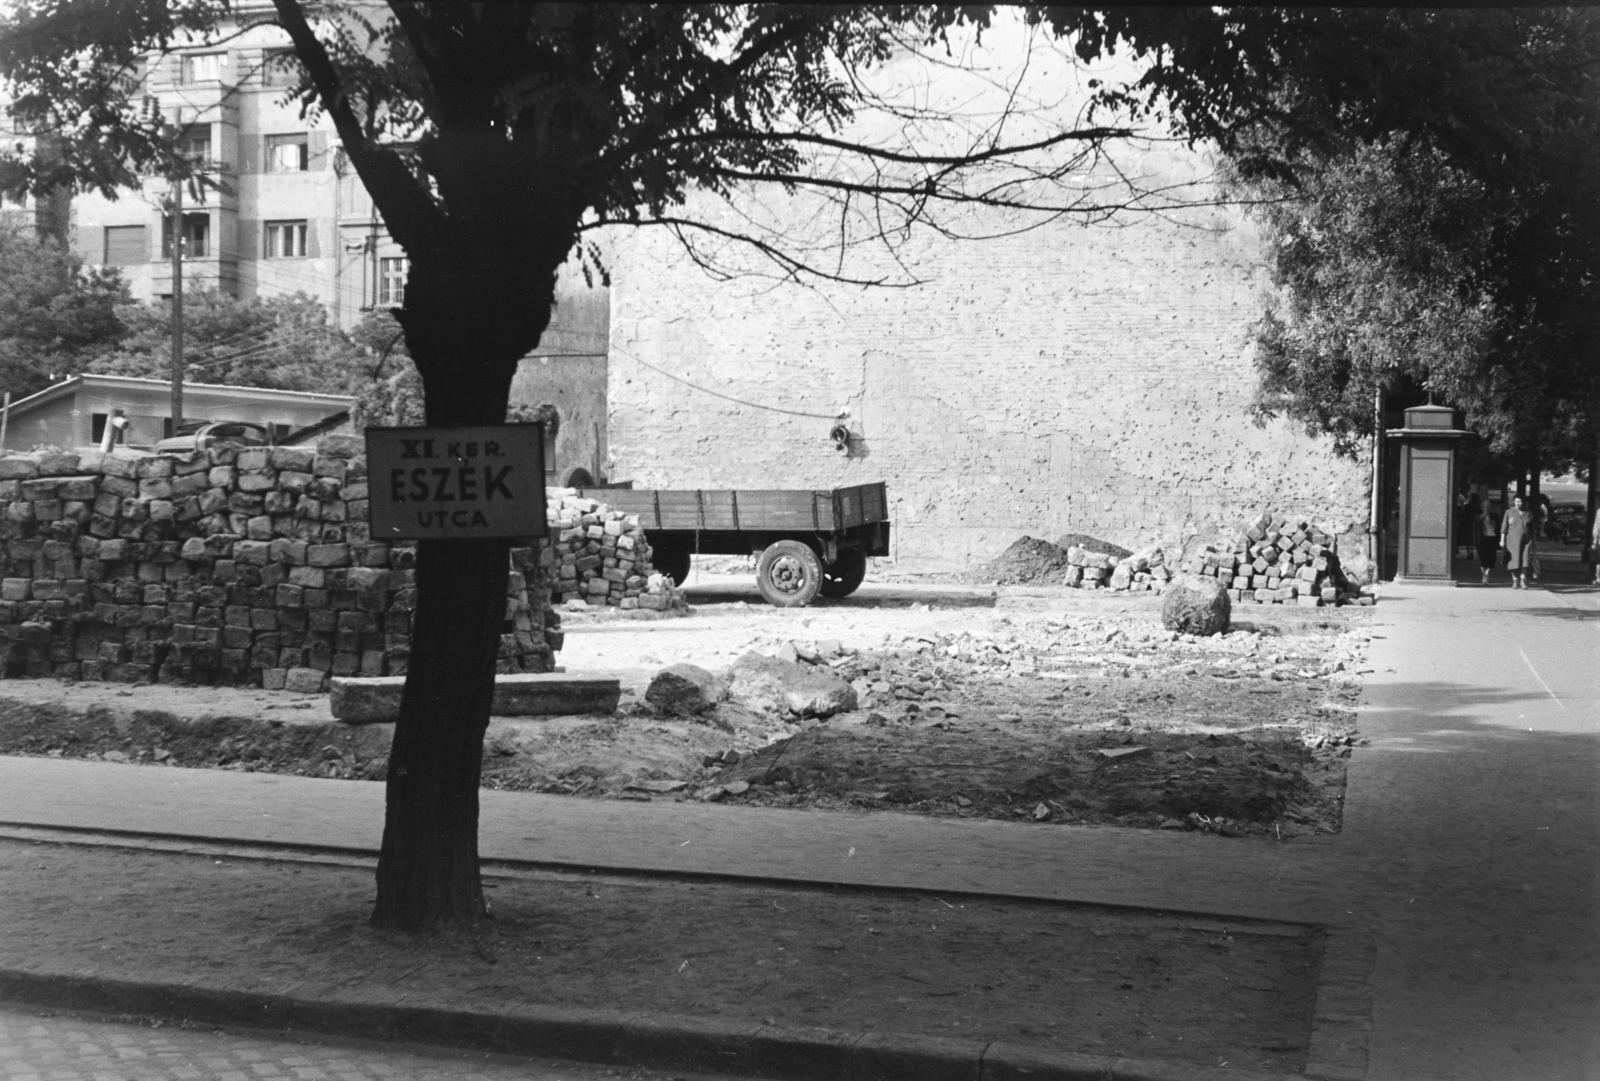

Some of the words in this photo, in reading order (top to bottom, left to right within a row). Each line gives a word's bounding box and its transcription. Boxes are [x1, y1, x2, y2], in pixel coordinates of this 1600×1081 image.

[399, 438, 440, 459] XI.
[447, 440, 506, 458] KER.
[390, 459, 515, 502] ESZÉK
[417, 510, 489, 528] UTCA
